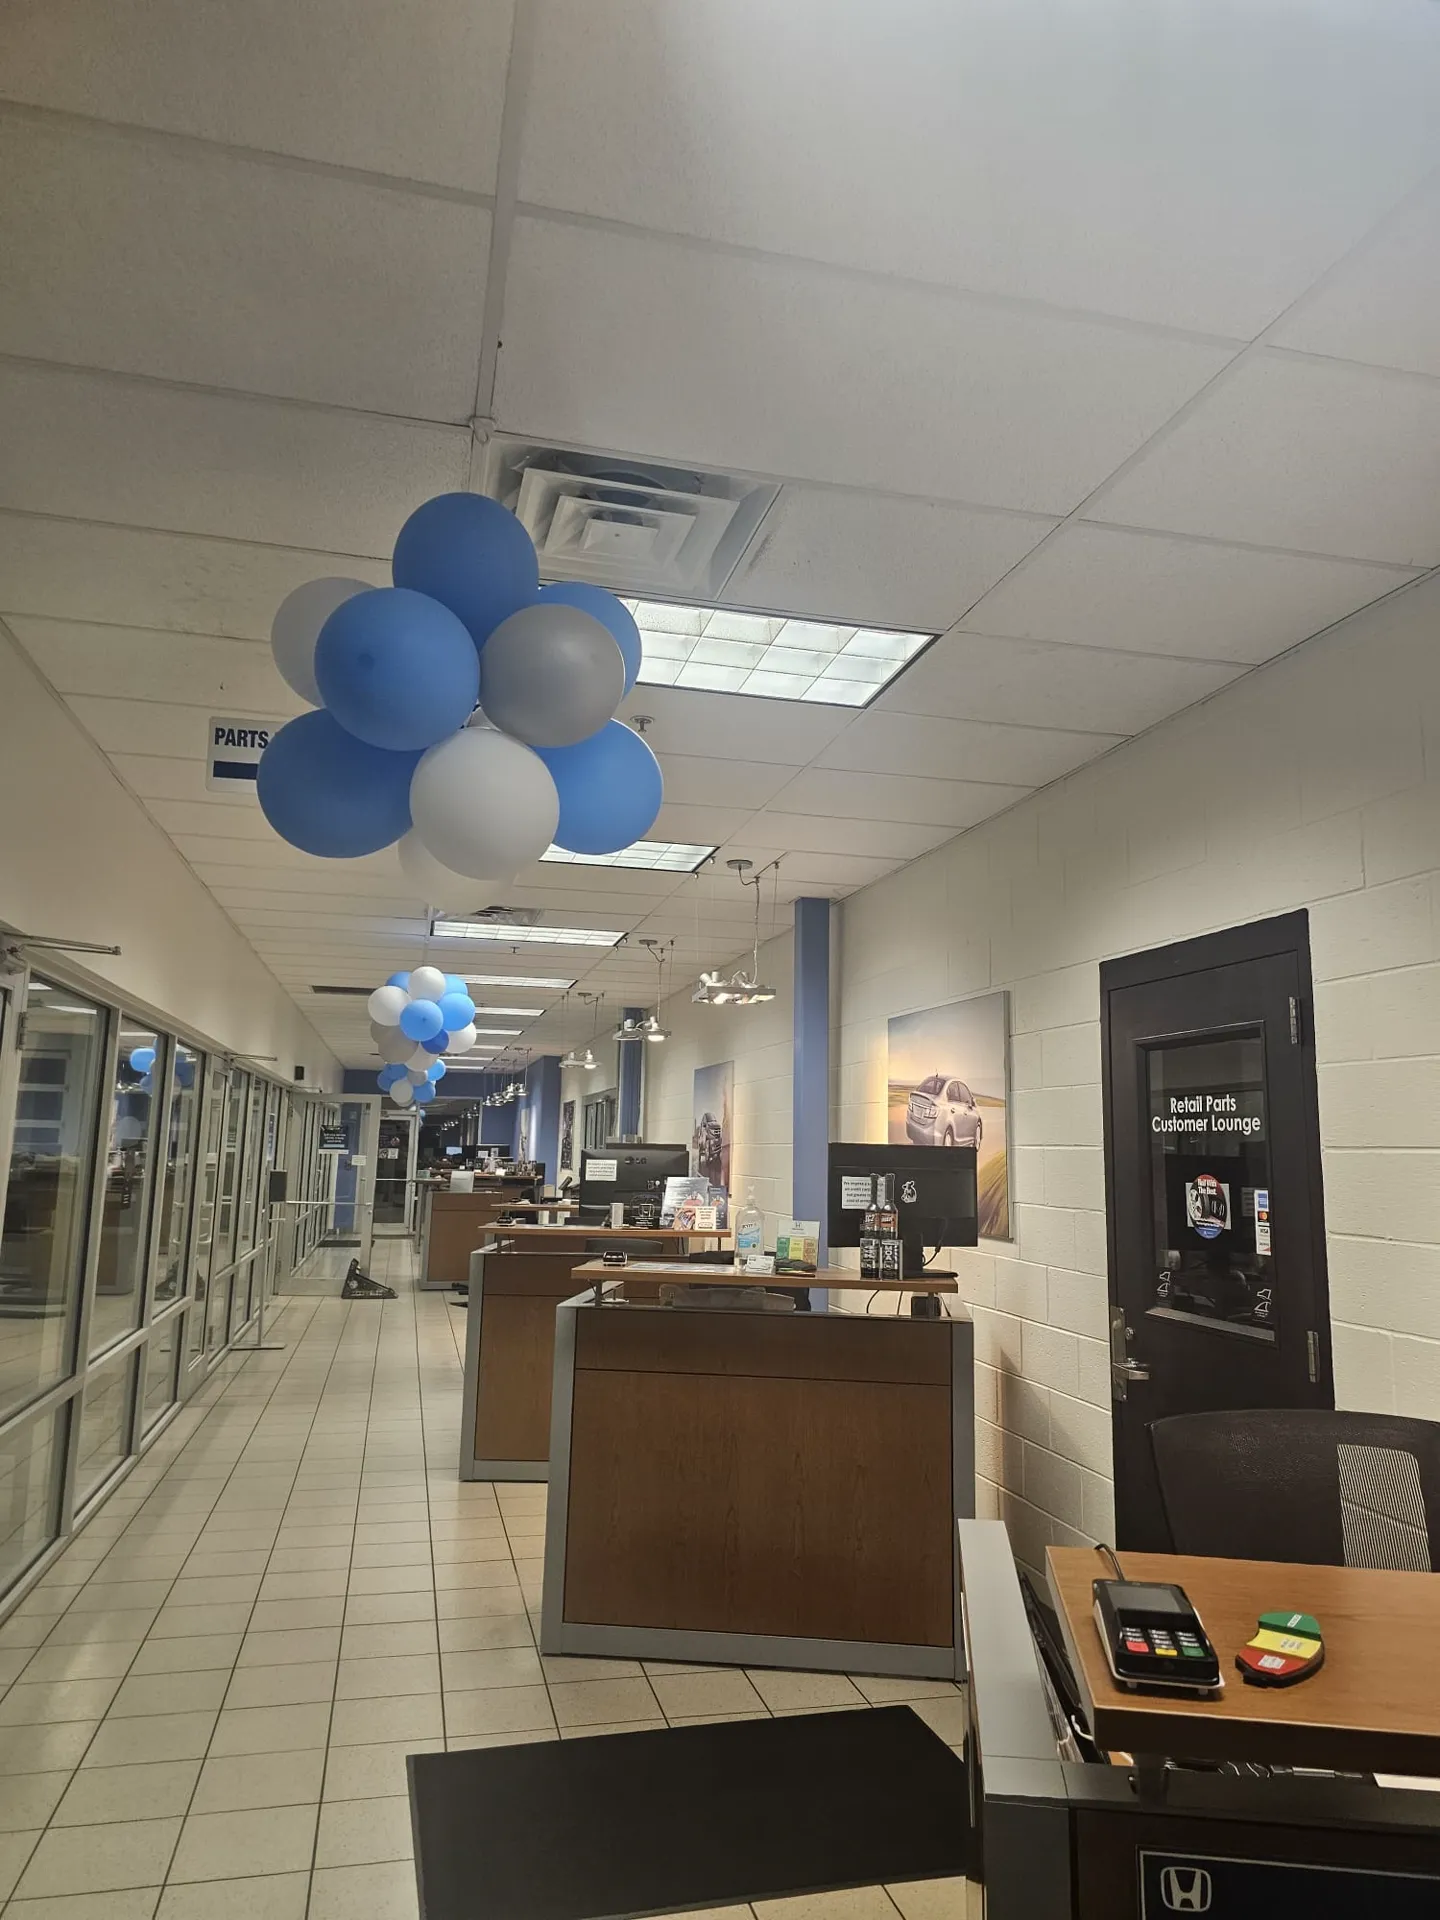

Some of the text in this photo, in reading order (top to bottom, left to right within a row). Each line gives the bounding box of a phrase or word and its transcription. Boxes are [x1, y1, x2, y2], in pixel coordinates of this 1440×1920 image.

[214, 727, 269, 749] PARTS
[1170, 1094, 1237, 1113] Retail Parts
[1152, 1114, 1261, 1135] Customer Lounge
